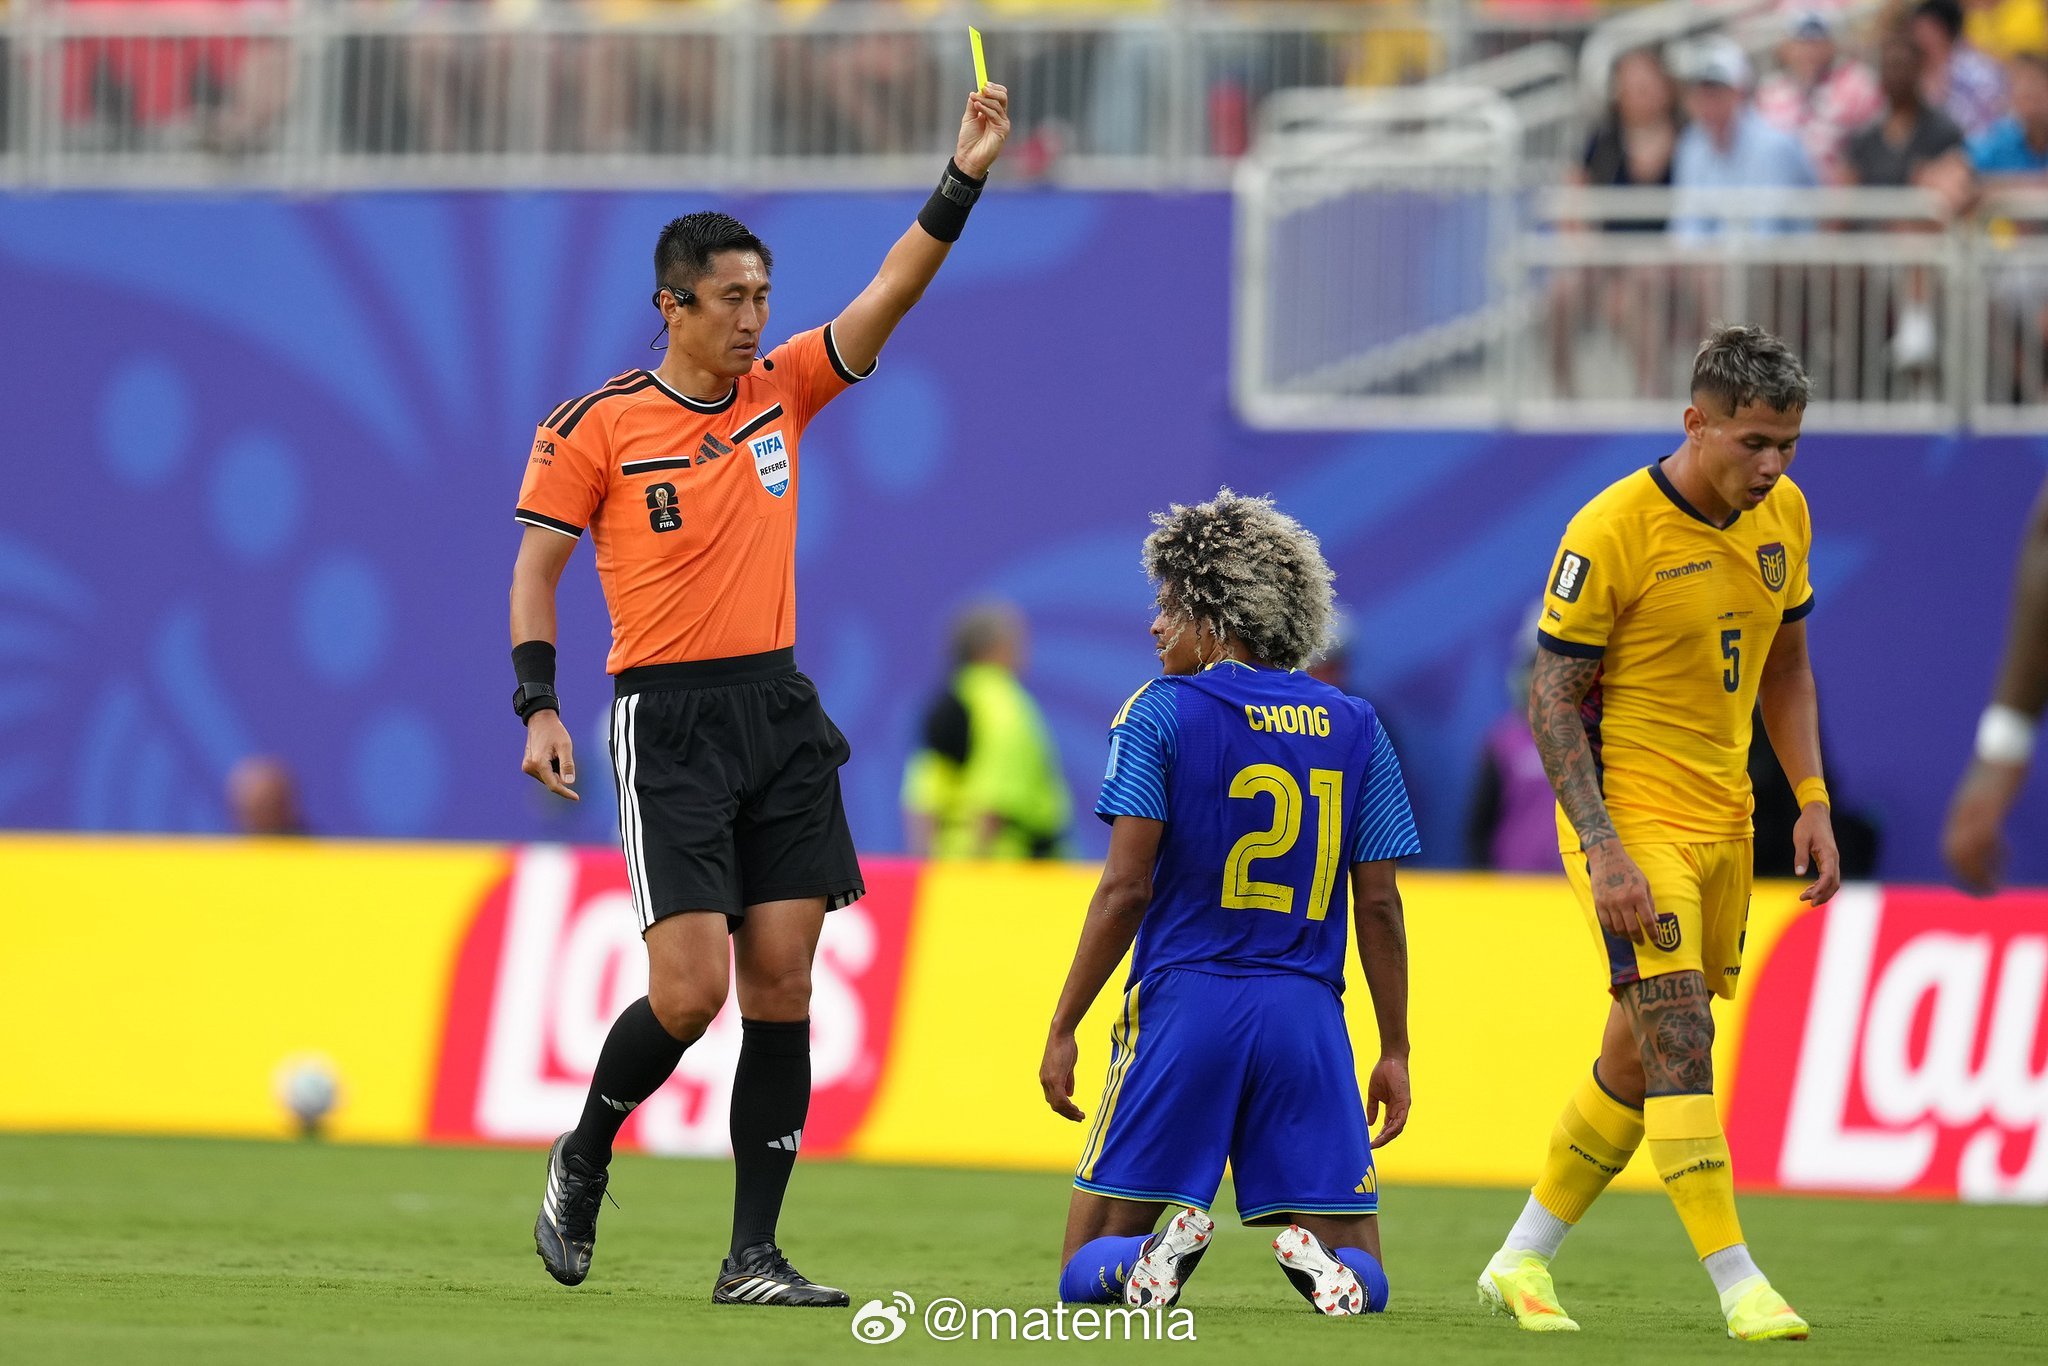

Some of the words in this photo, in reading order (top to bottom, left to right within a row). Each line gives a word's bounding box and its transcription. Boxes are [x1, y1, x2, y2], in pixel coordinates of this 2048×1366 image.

[753, 436, 783, 458] FIFA
[760, 459, 788, 476] REFEREE
[659, 520, 675, 529] FIFA
[1656, 560, 1712, 581] marathon
[1721, 629, 1742, 694] 5
[1244, 704, 1331, 738] CHONG
[1220, 763, 1344, 922] 21
[1664, 1158, 1725, 1185] marathon
